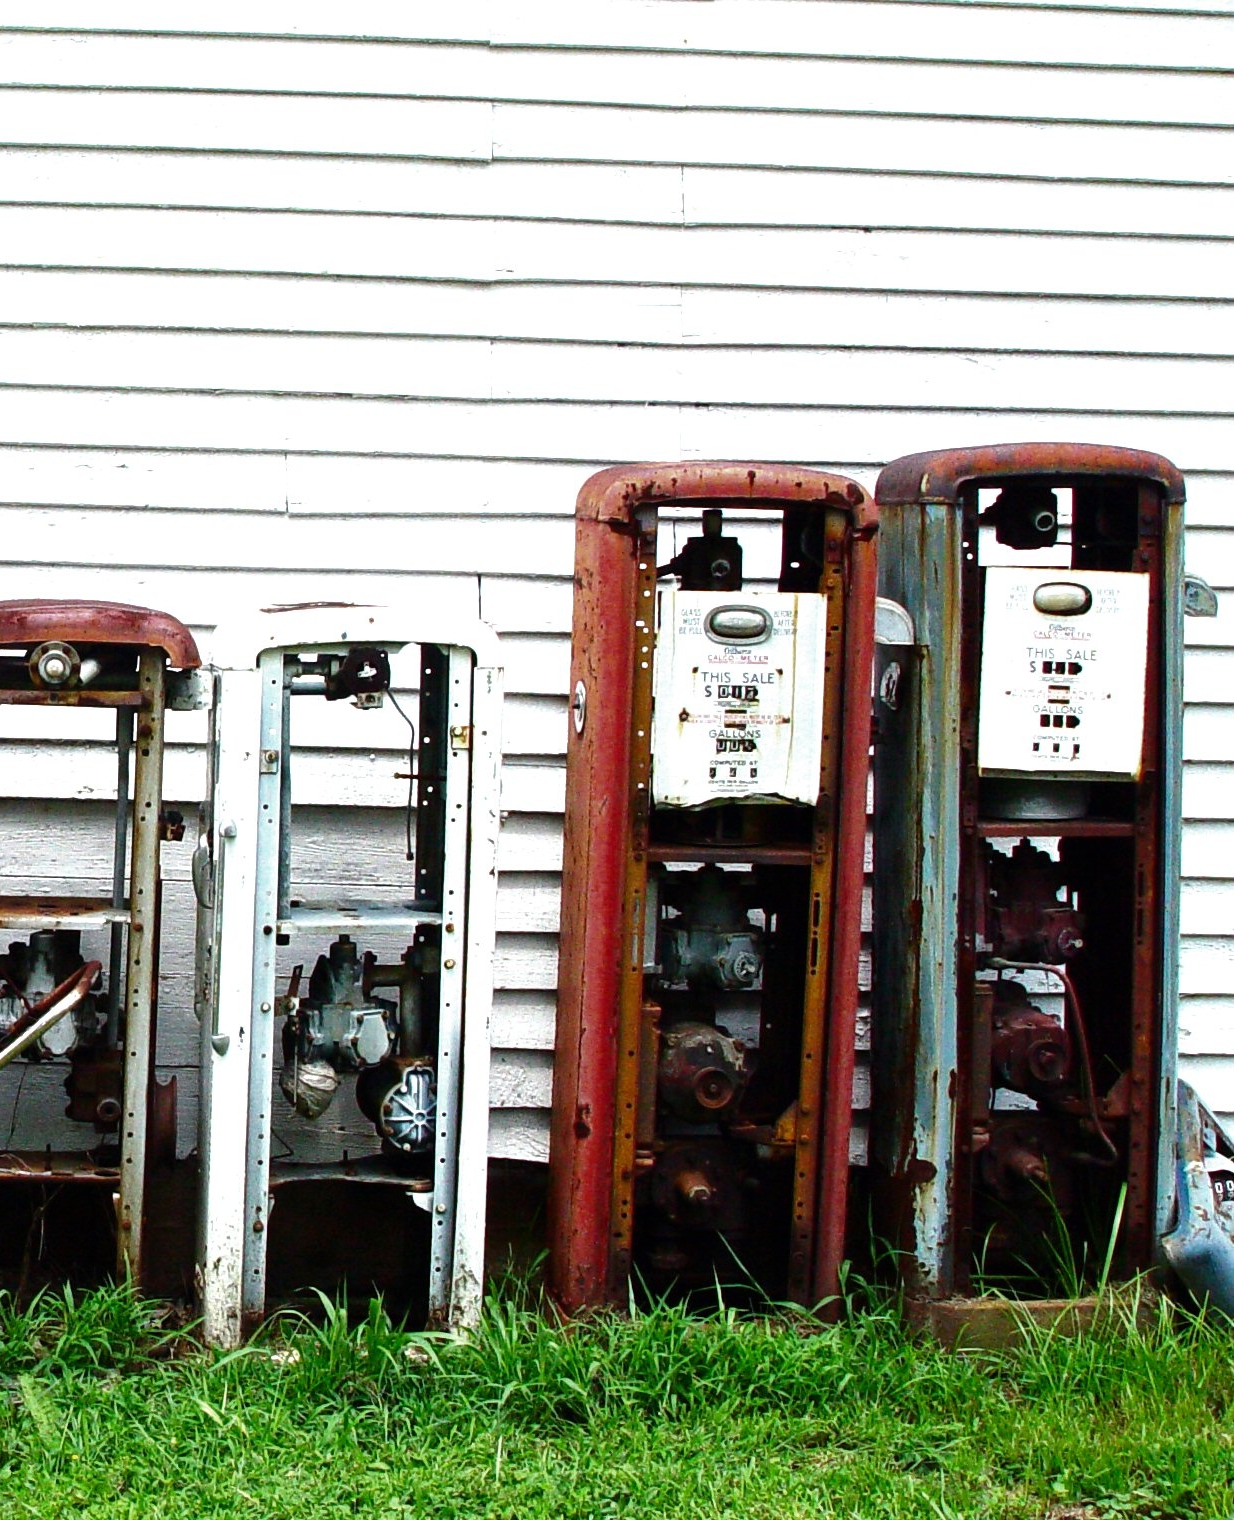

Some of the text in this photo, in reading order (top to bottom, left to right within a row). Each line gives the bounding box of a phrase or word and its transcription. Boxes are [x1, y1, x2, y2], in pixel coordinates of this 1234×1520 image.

[1026, 647, 1097, 661] THIS SALE
[701, 672, 775, 684] THIS SALE
[1033, 705, 1083, 714] GALLONS
[709, 729, 761, 739] GALLONS
